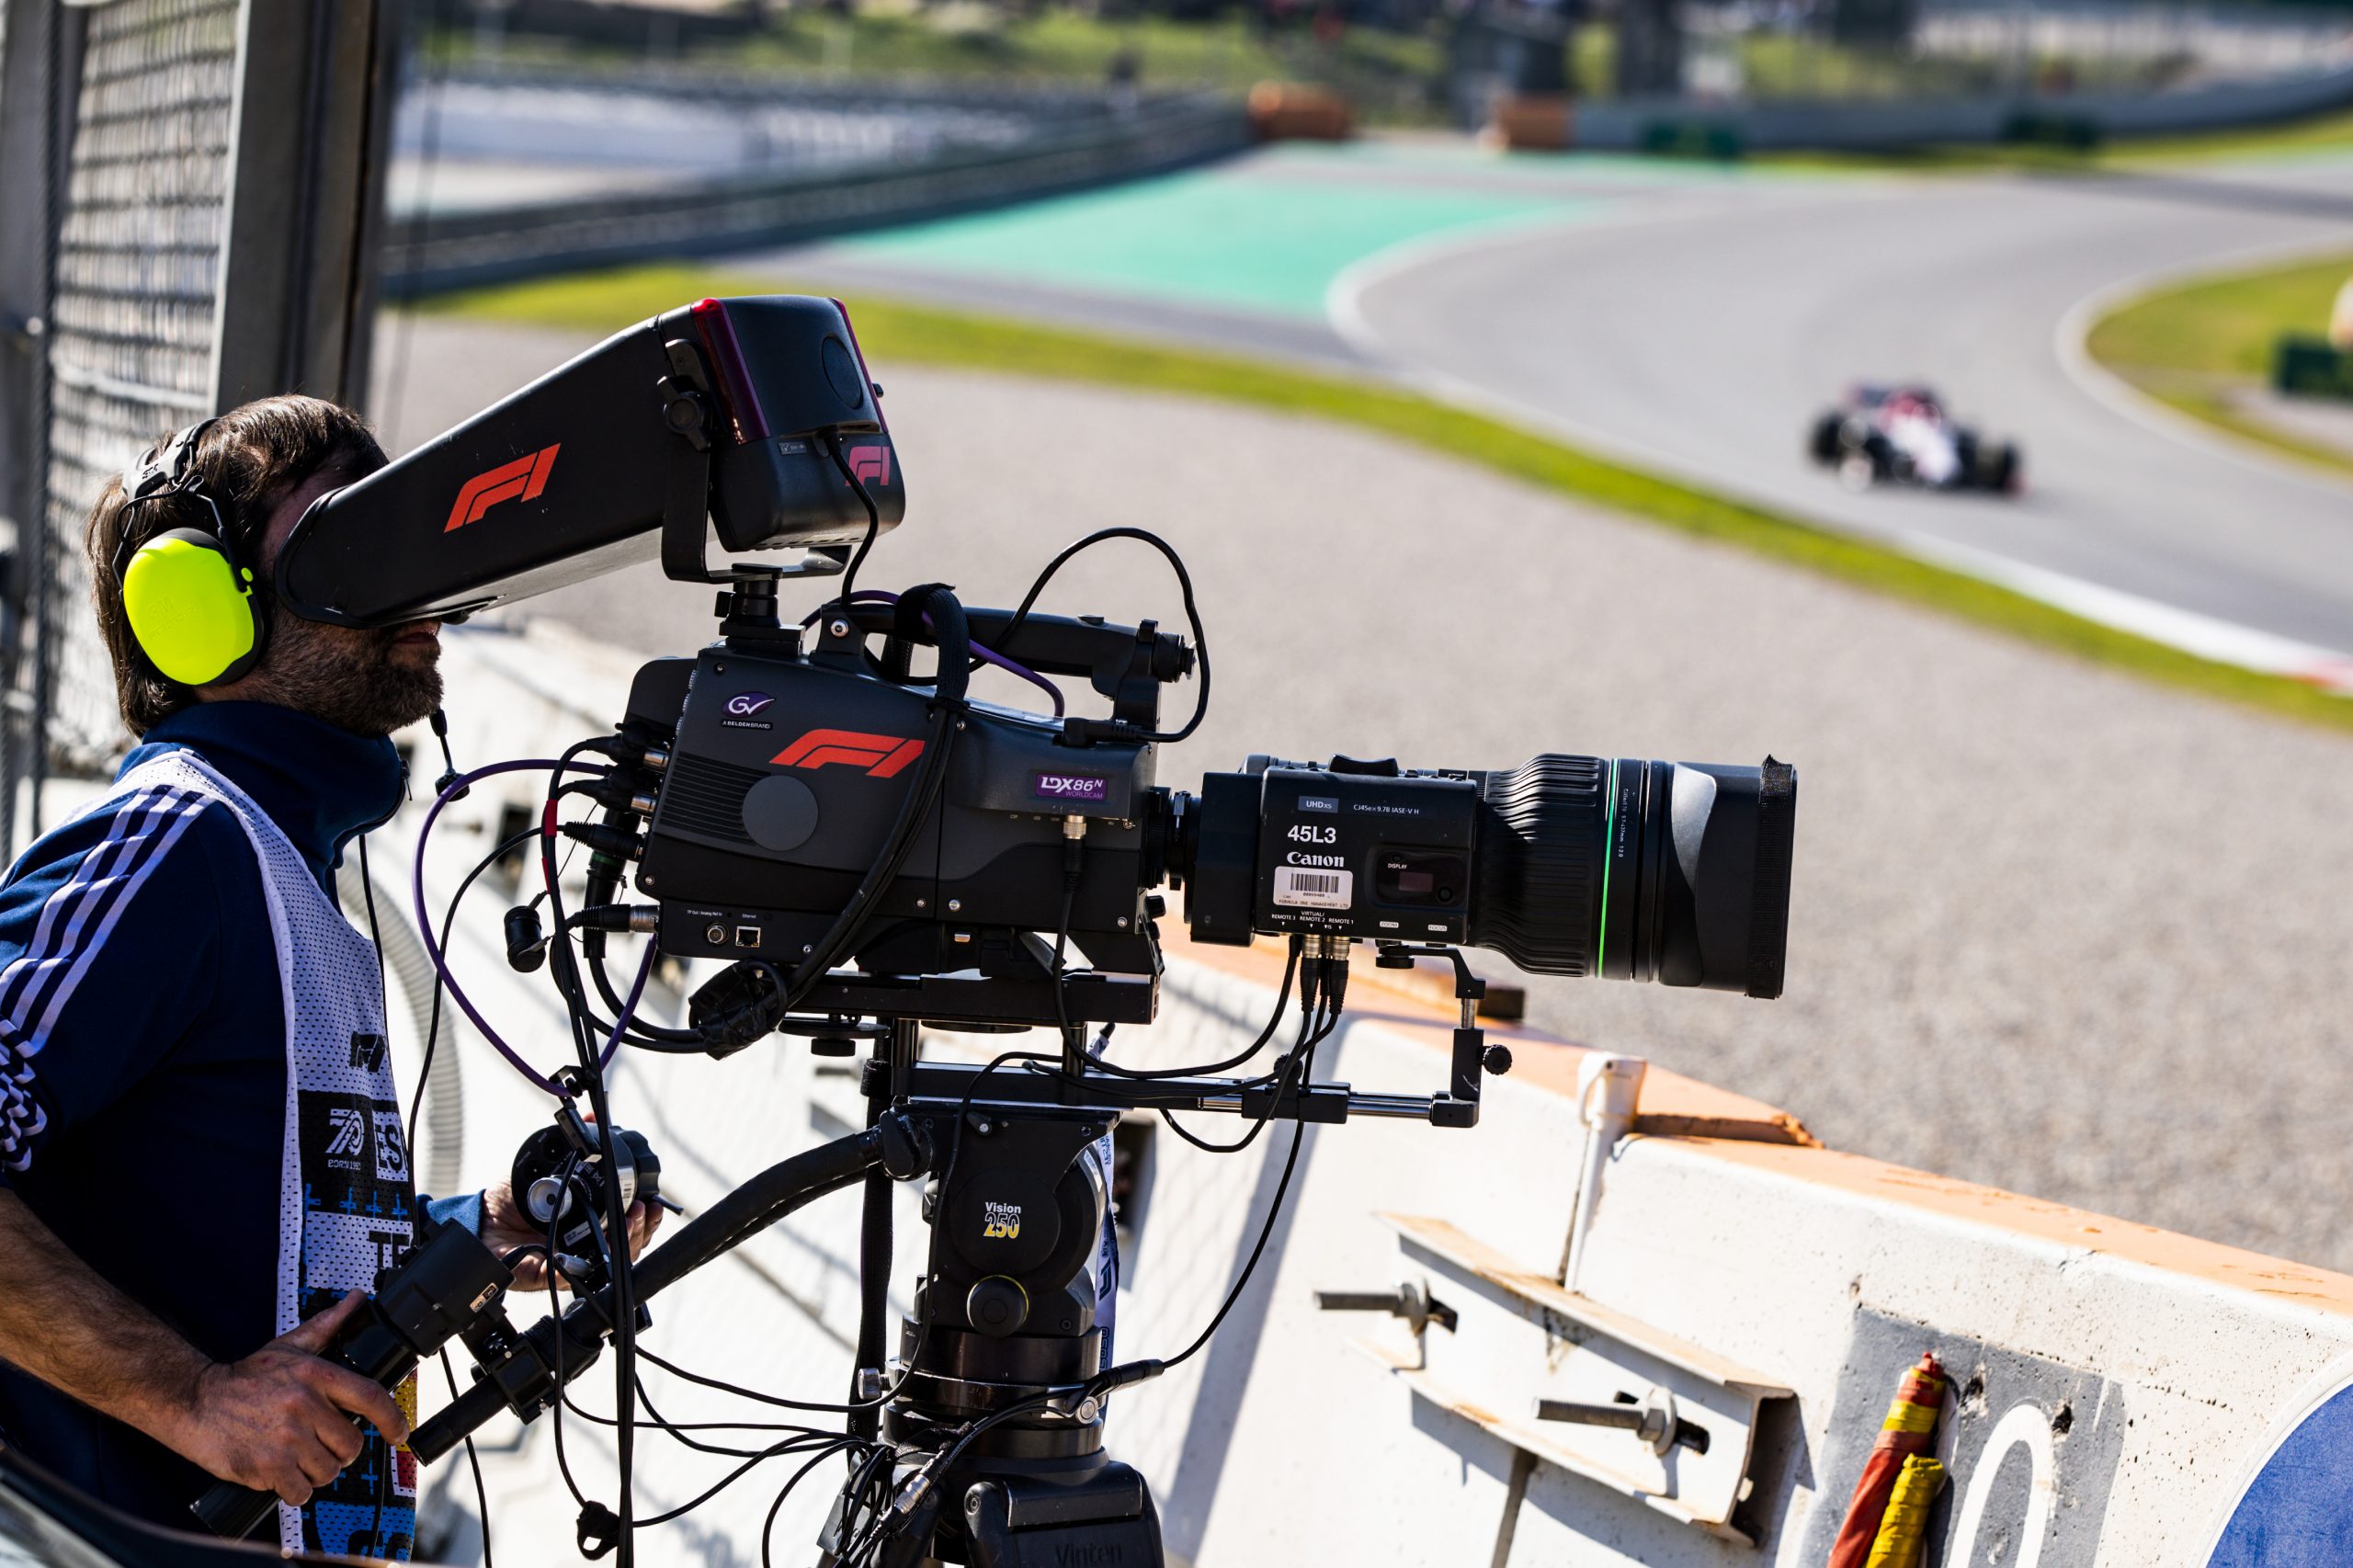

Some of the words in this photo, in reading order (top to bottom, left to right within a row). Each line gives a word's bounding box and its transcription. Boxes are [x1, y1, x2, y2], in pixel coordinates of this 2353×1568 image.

[443, 443, 561, 533] F1
[768, 729, 926, 778] F1
[1065, 790, 1103, 800] WORLDCAM
[1287, 825, 1336, 844] 45L3
[1287, 851, 1345, 868] Canon
[325, 1108, 365, 1156] 70
[327, 1159, 349, 1169] BORN
[985, 1201, 1021, 1213] Vision
[983, 1211, 1020, 1239] 250
